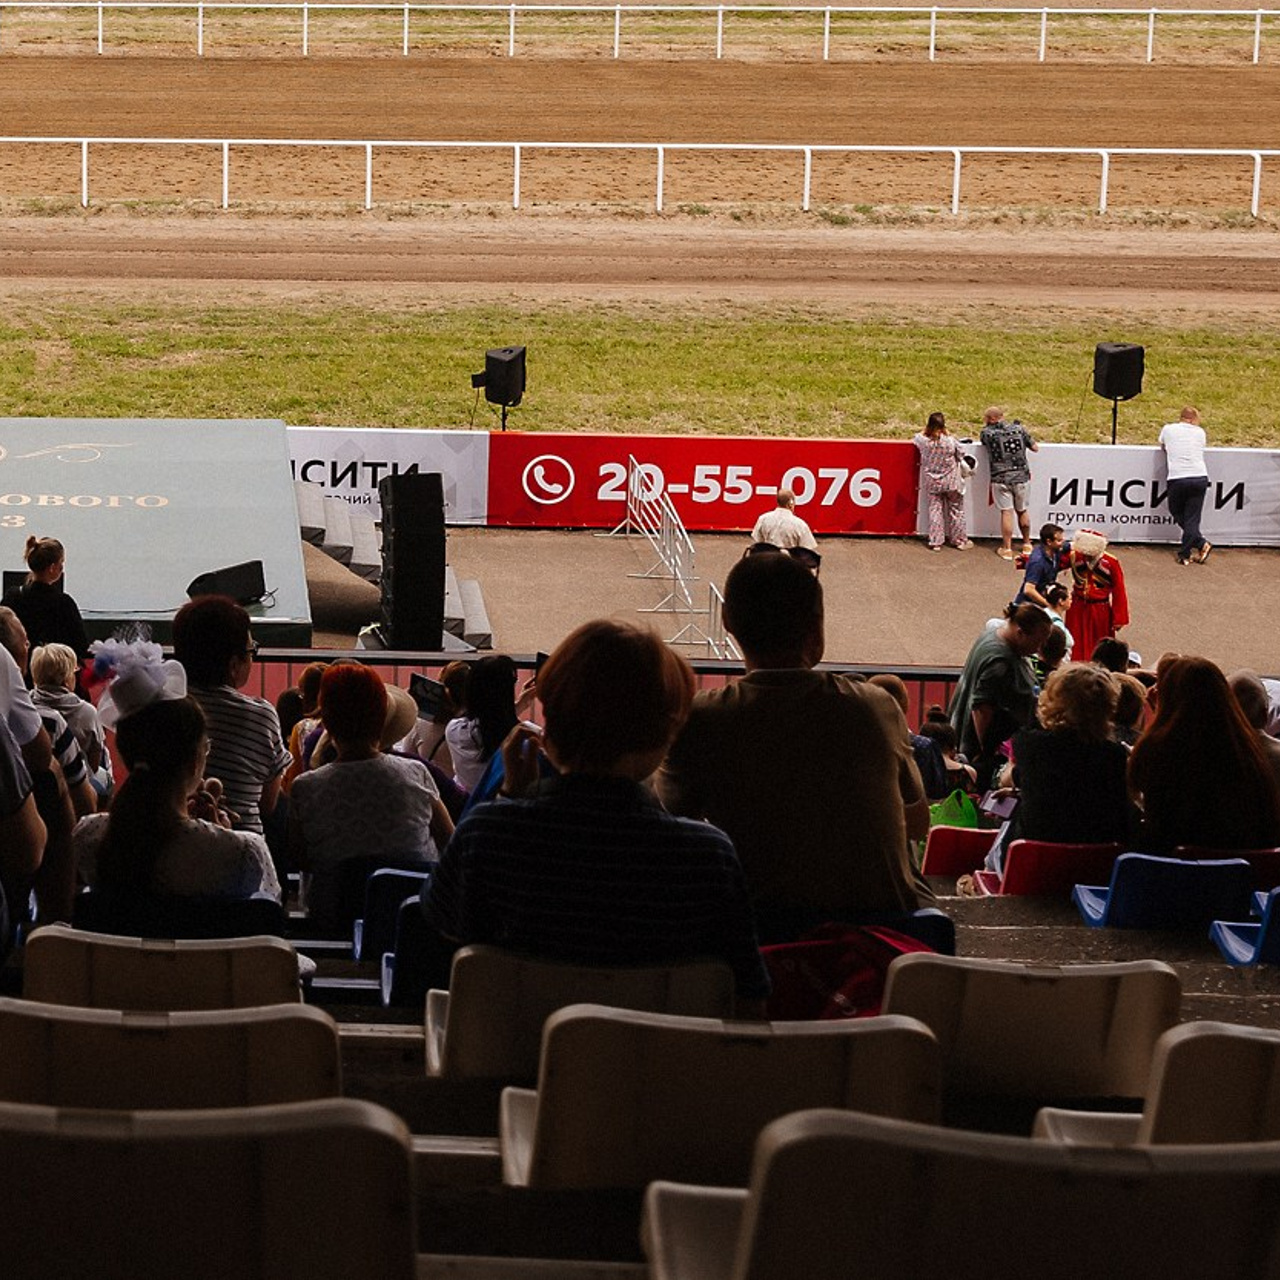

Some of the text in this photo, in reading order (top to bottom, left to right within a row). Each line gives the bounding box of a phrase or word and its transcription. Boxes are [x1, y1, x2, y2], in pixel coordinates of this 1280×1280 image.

[597, 463, 883, 507] 20-55-076
[1048, 477, 1246, 510] ИНСИИ
[1047, 511, 1176, 525] группа компан
